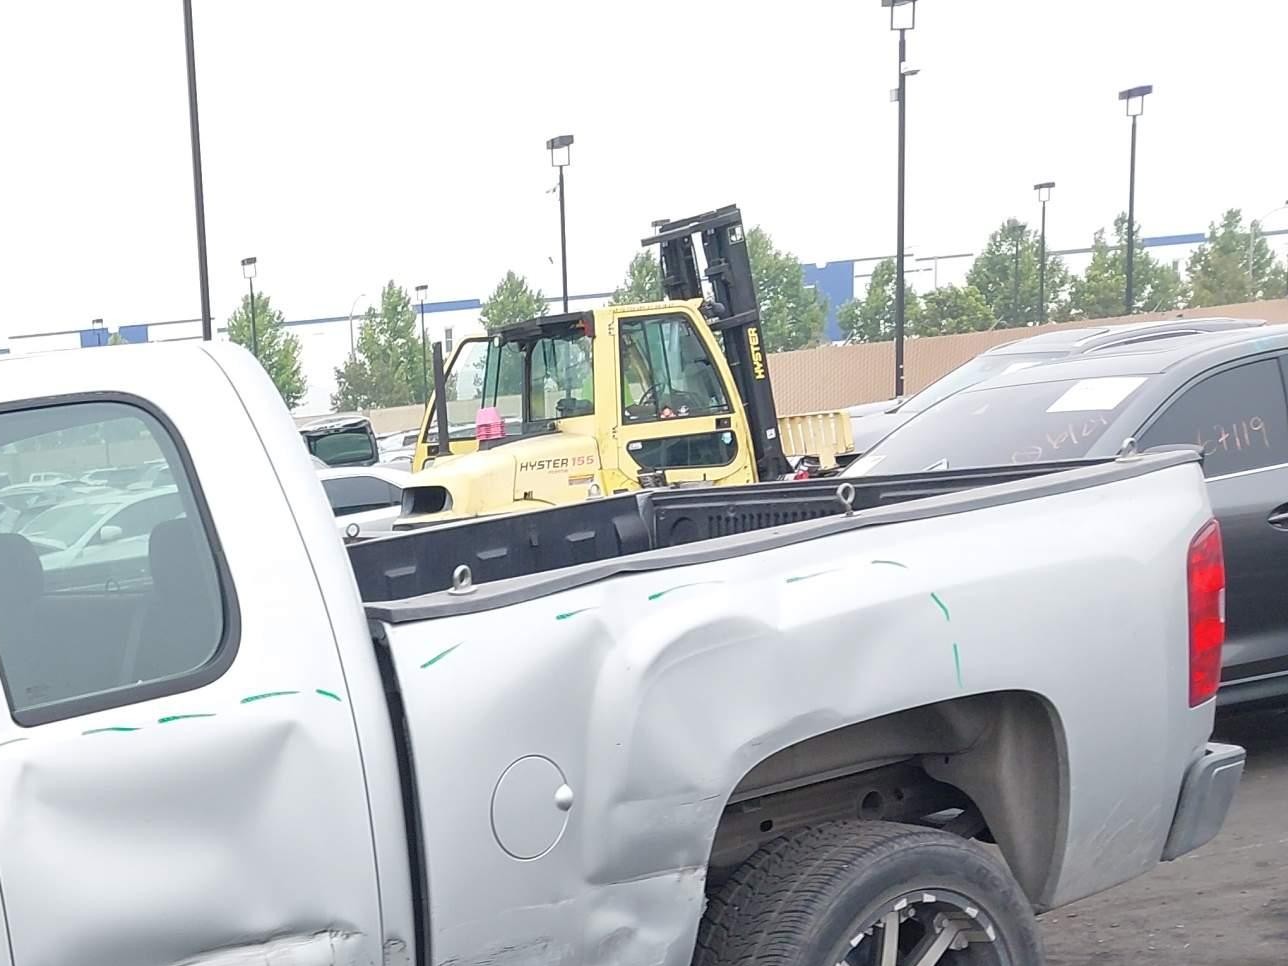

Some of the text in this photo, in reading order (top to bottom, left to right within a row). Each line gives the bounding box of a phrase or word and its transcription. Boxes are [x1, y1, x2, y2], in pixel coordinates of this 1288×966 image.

[747, 327, 766, 380] HYSTER
[519, 457, 569, 472] HYSTER
[571, 455, 594, 467] 155
